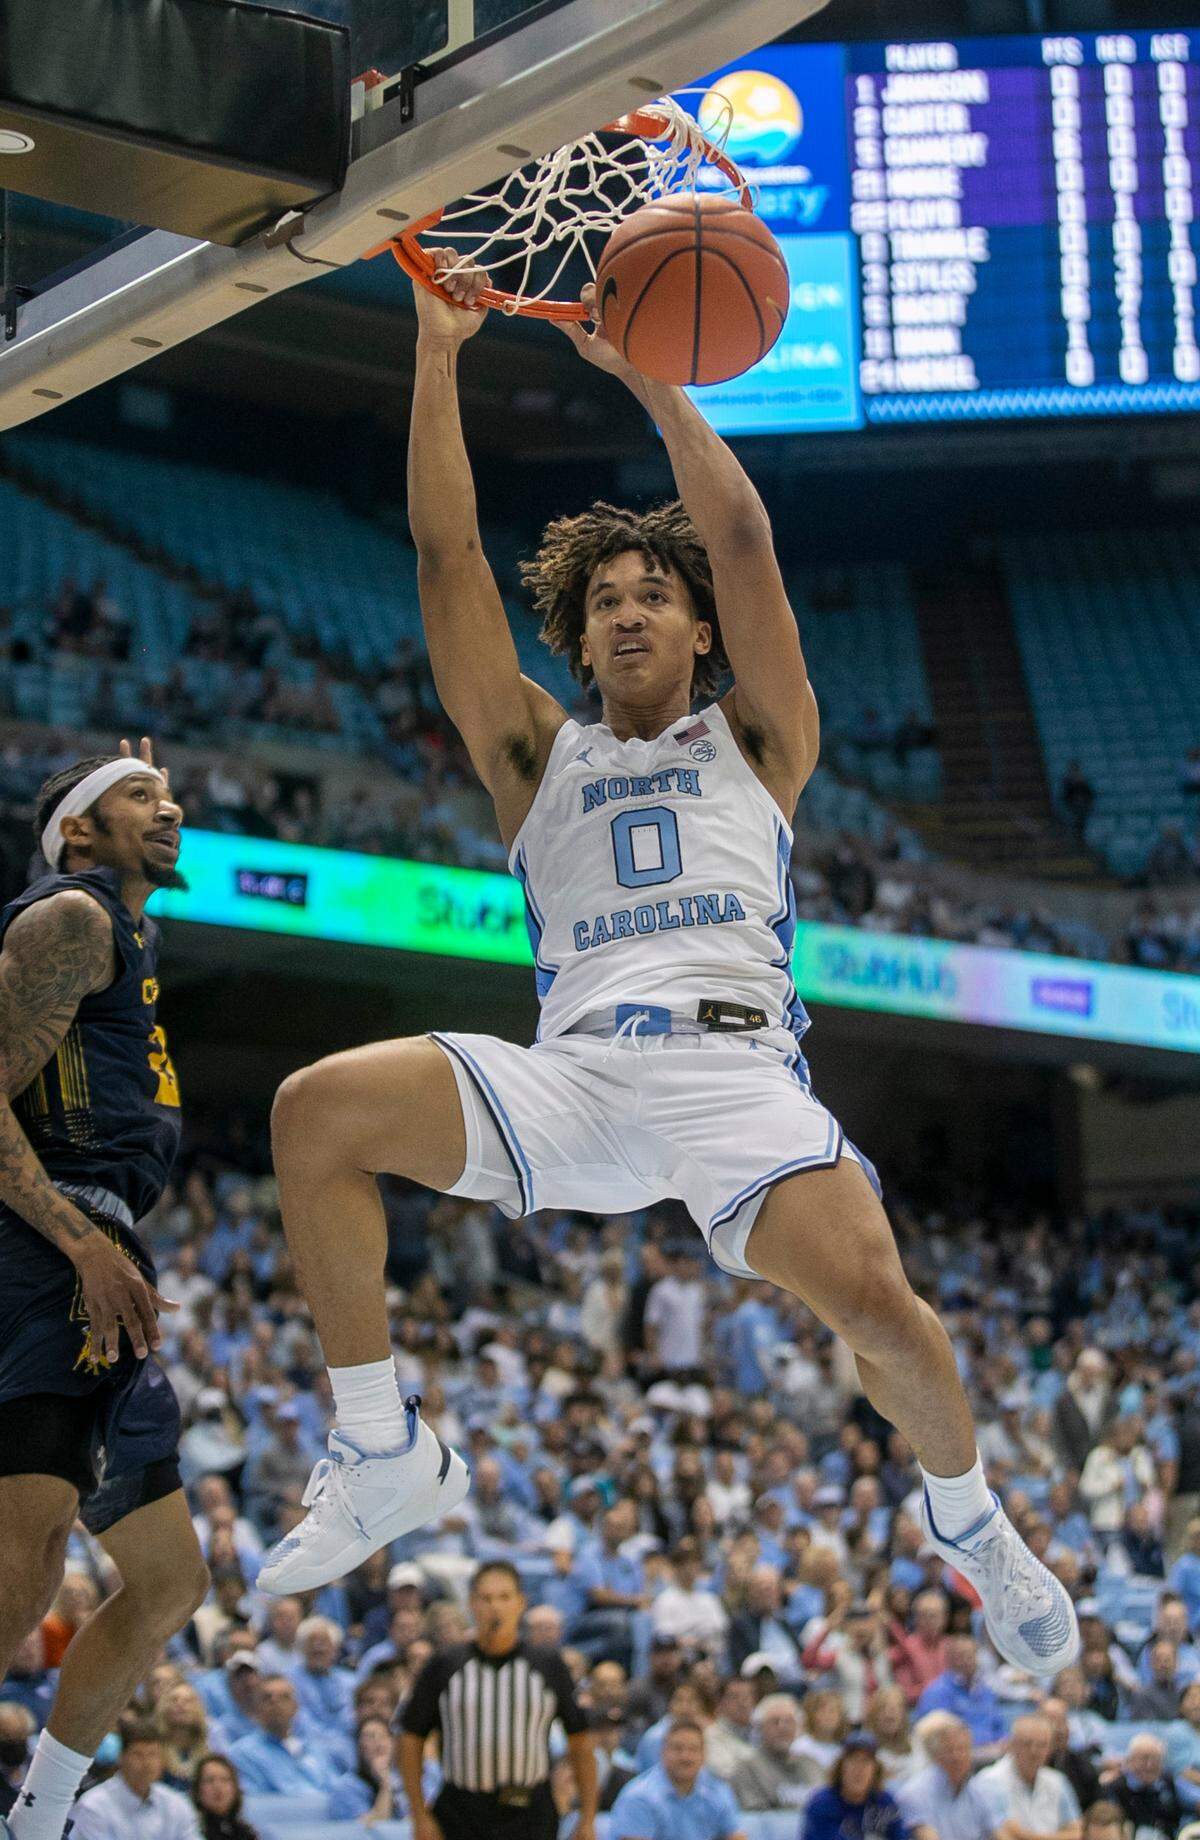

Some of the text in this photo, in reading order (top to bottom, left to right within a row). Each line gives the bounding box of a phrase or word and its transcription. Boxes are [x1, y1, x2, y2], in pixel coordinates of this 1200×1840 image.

[885, 42, 958, 71] PLAYER
[1041, 37, 1084, 65] PTS
[1151, 33, 1191, 62] AST
[1050, 65, 1079, 96] 0
[1104, 63, 1132, 95] 0
[1158, 62, 1186, 93] 0
[1052, 96, 1081, 128] 0
[1106, 95, 1135, 126] 0
[1159, 93, 1188, 126] 0
[1107, 126, 1136, 158] 0
[1056, 155, 1191, 192] 0 0 0
[1058, 191, 1086, 222] 0
[1165, 188, 1193, 223] 0
[1059, 222, 1088, 254] 0
[1112, 220, 1142, 252] 0
[862, 263, 888, 294] 3
[891, 260, 976, 294] STYLES
[1061, 254, 1089, 286] 0
[1168, 249, 1196, 286] 0
[1065, 349, 1095, 387] 0
[1119, 347, 1149, 385] 0
[1173, 345, 1200, 382] 0
[582, 768, 702, 813] NORTH
[610, 806, 683, 889] 0
[573, 893, 746, 951] CAROLINA
